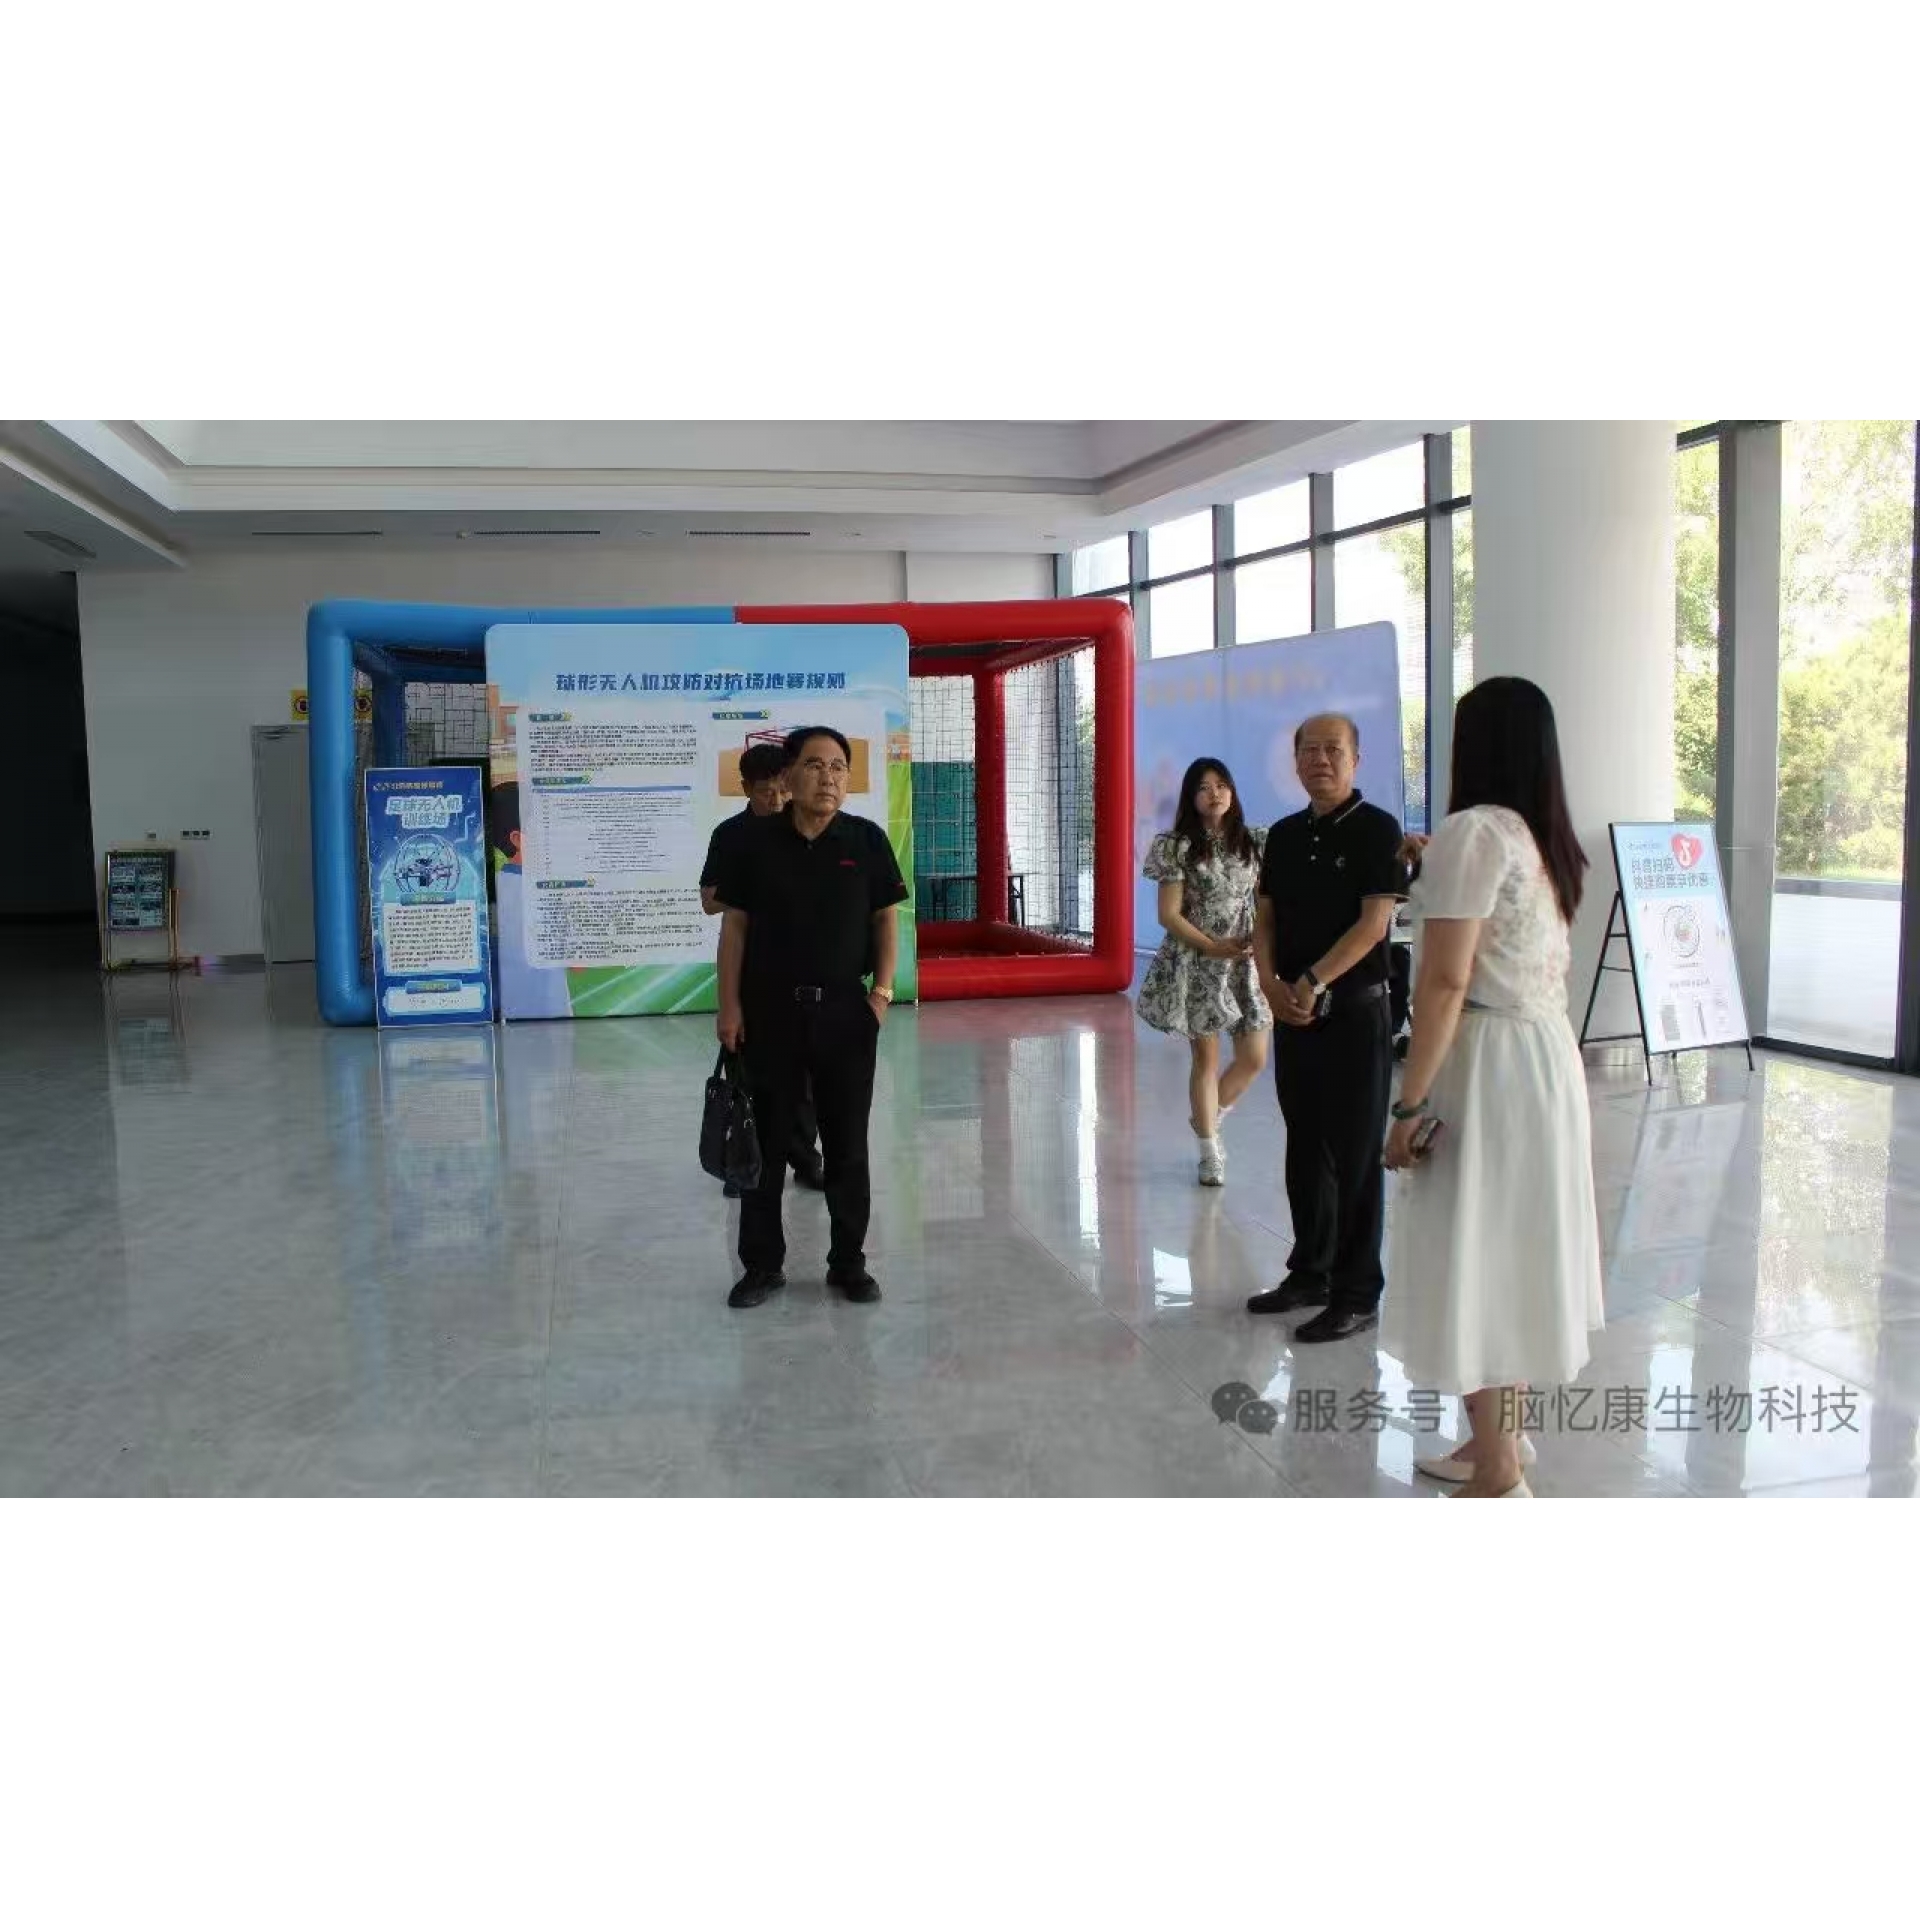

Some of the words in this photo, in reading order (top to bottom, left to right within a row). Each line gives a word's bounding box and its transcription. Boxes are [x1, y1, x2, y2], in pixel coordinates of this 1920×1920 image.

[556, 672, 846, 691] 球形无人机攻防对抗场地赛规则
